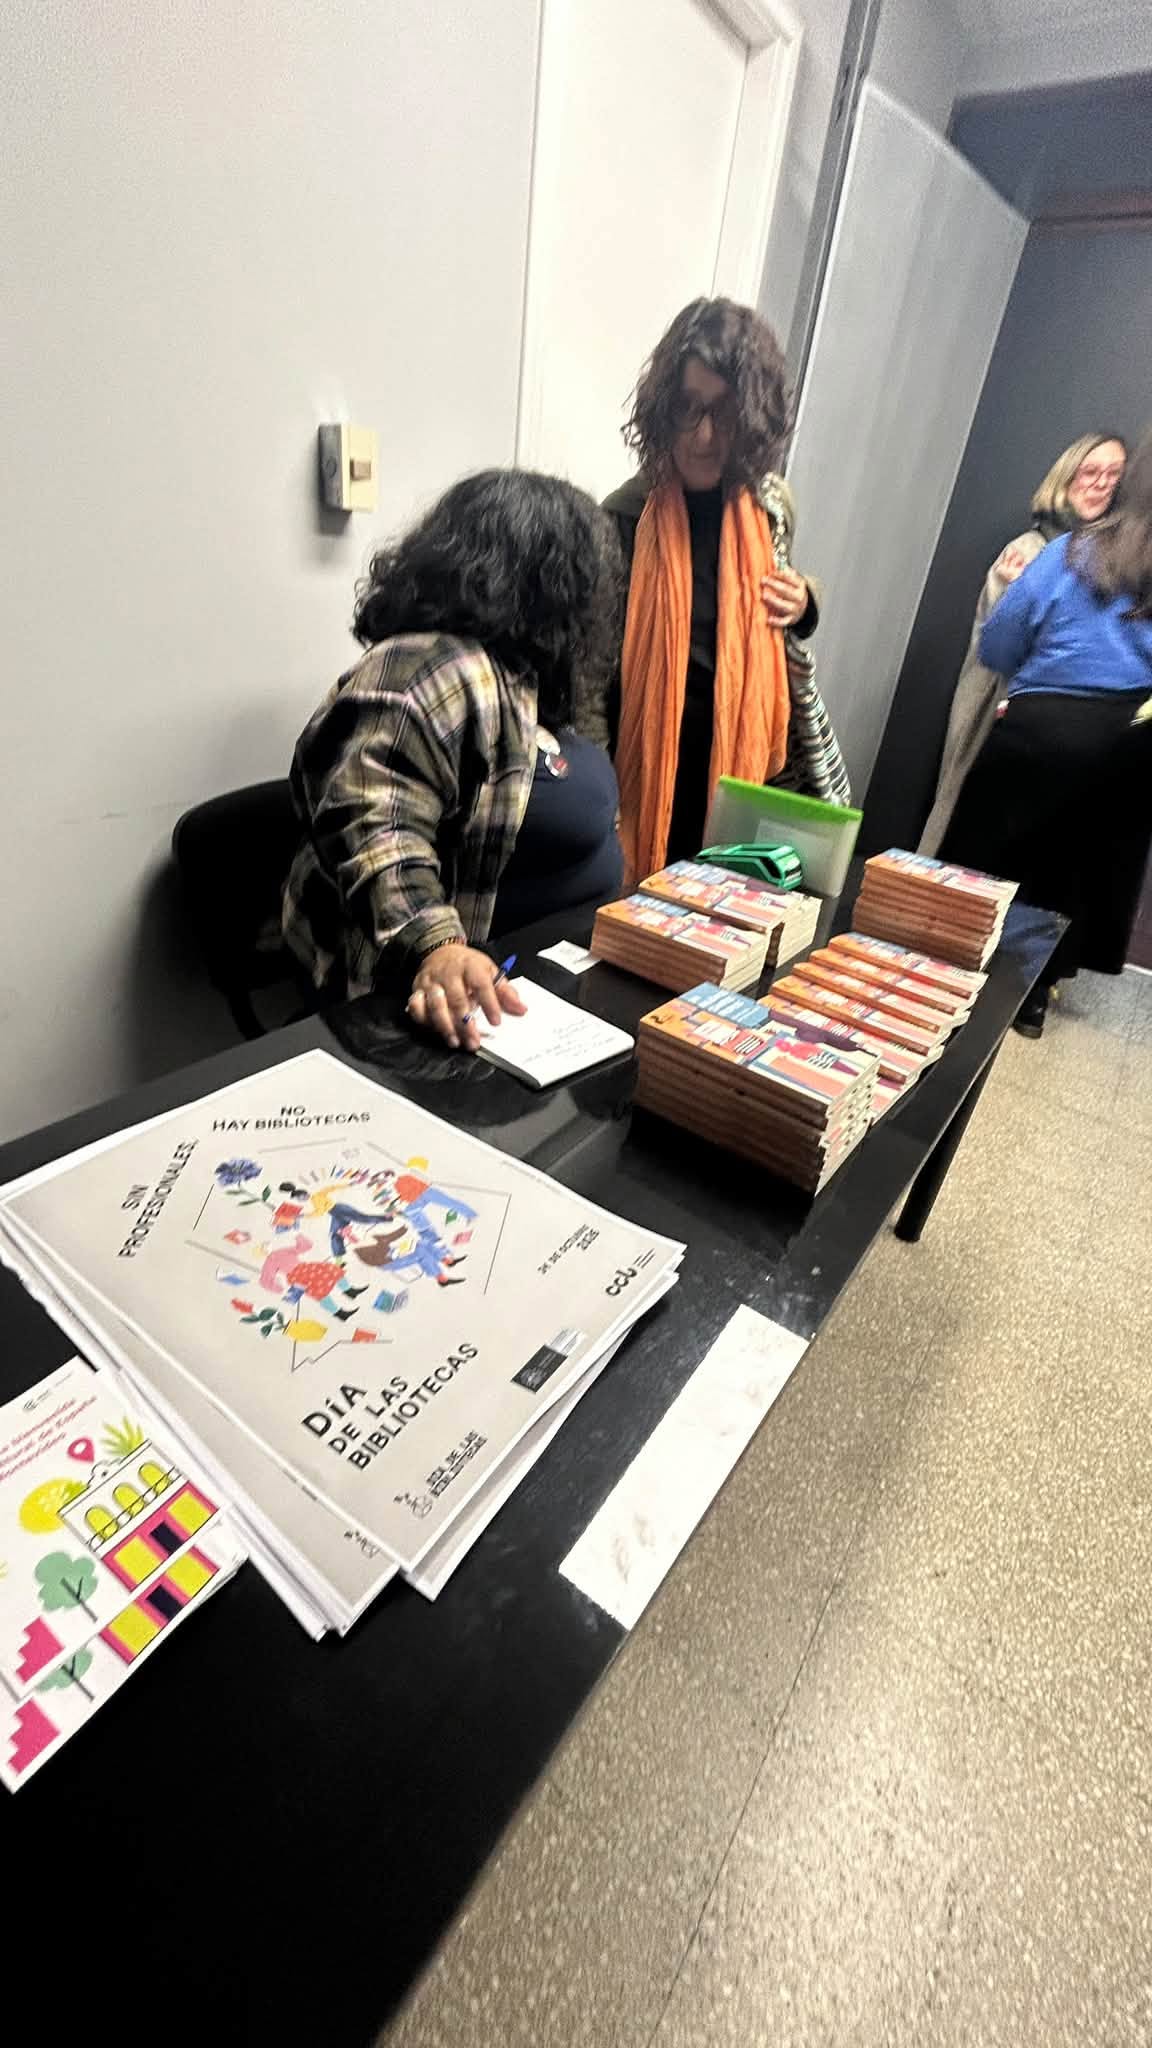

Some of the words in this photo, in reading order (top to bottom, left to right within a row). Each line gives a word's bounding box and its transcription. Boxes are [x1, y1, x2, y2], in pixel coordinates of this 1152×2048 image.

[212, 1118, 250, 1133] HAY
[255, 1111, 371, 1130] BIBLIOTECAS
[279, 1105, 306, 1117] NO
[121, 1184, 150, 1211] SIN
[301, 1383, 368, 1438] DÍA
[327, 1423, 362, 1456] DE
[365, 1376, 409, 1419] LAS
[347, 1343, 479, 1471] BIBLIOTECAS
